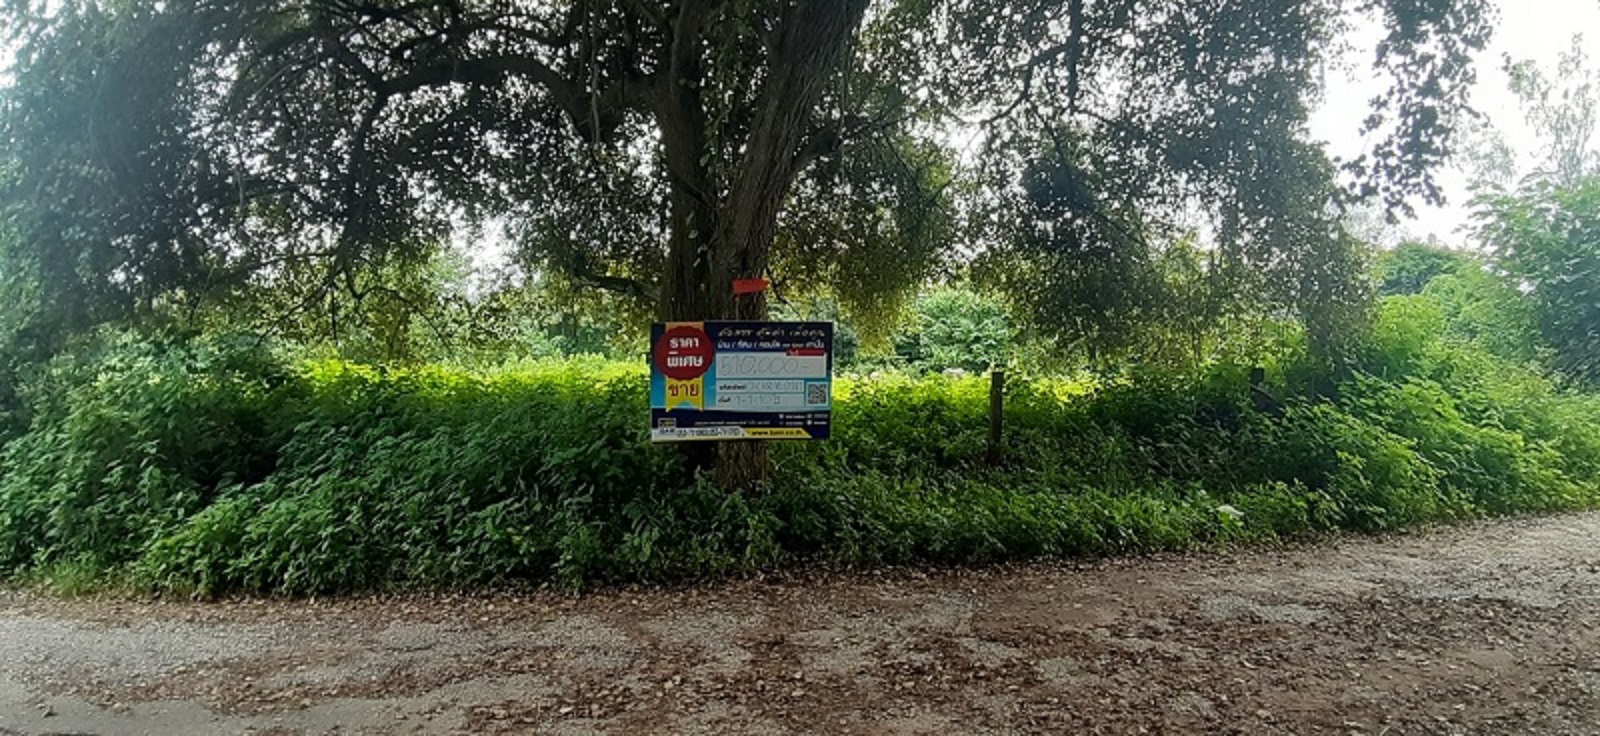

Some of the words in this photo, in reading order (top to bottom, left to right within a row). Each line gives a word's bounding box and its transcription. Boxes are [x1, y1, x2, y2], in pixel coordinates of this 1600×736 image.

[669, 337, 699, 349] ราคา
[667, 351, 704, 367] พิเศษ
[668, 383, 700, 397] ขาย
